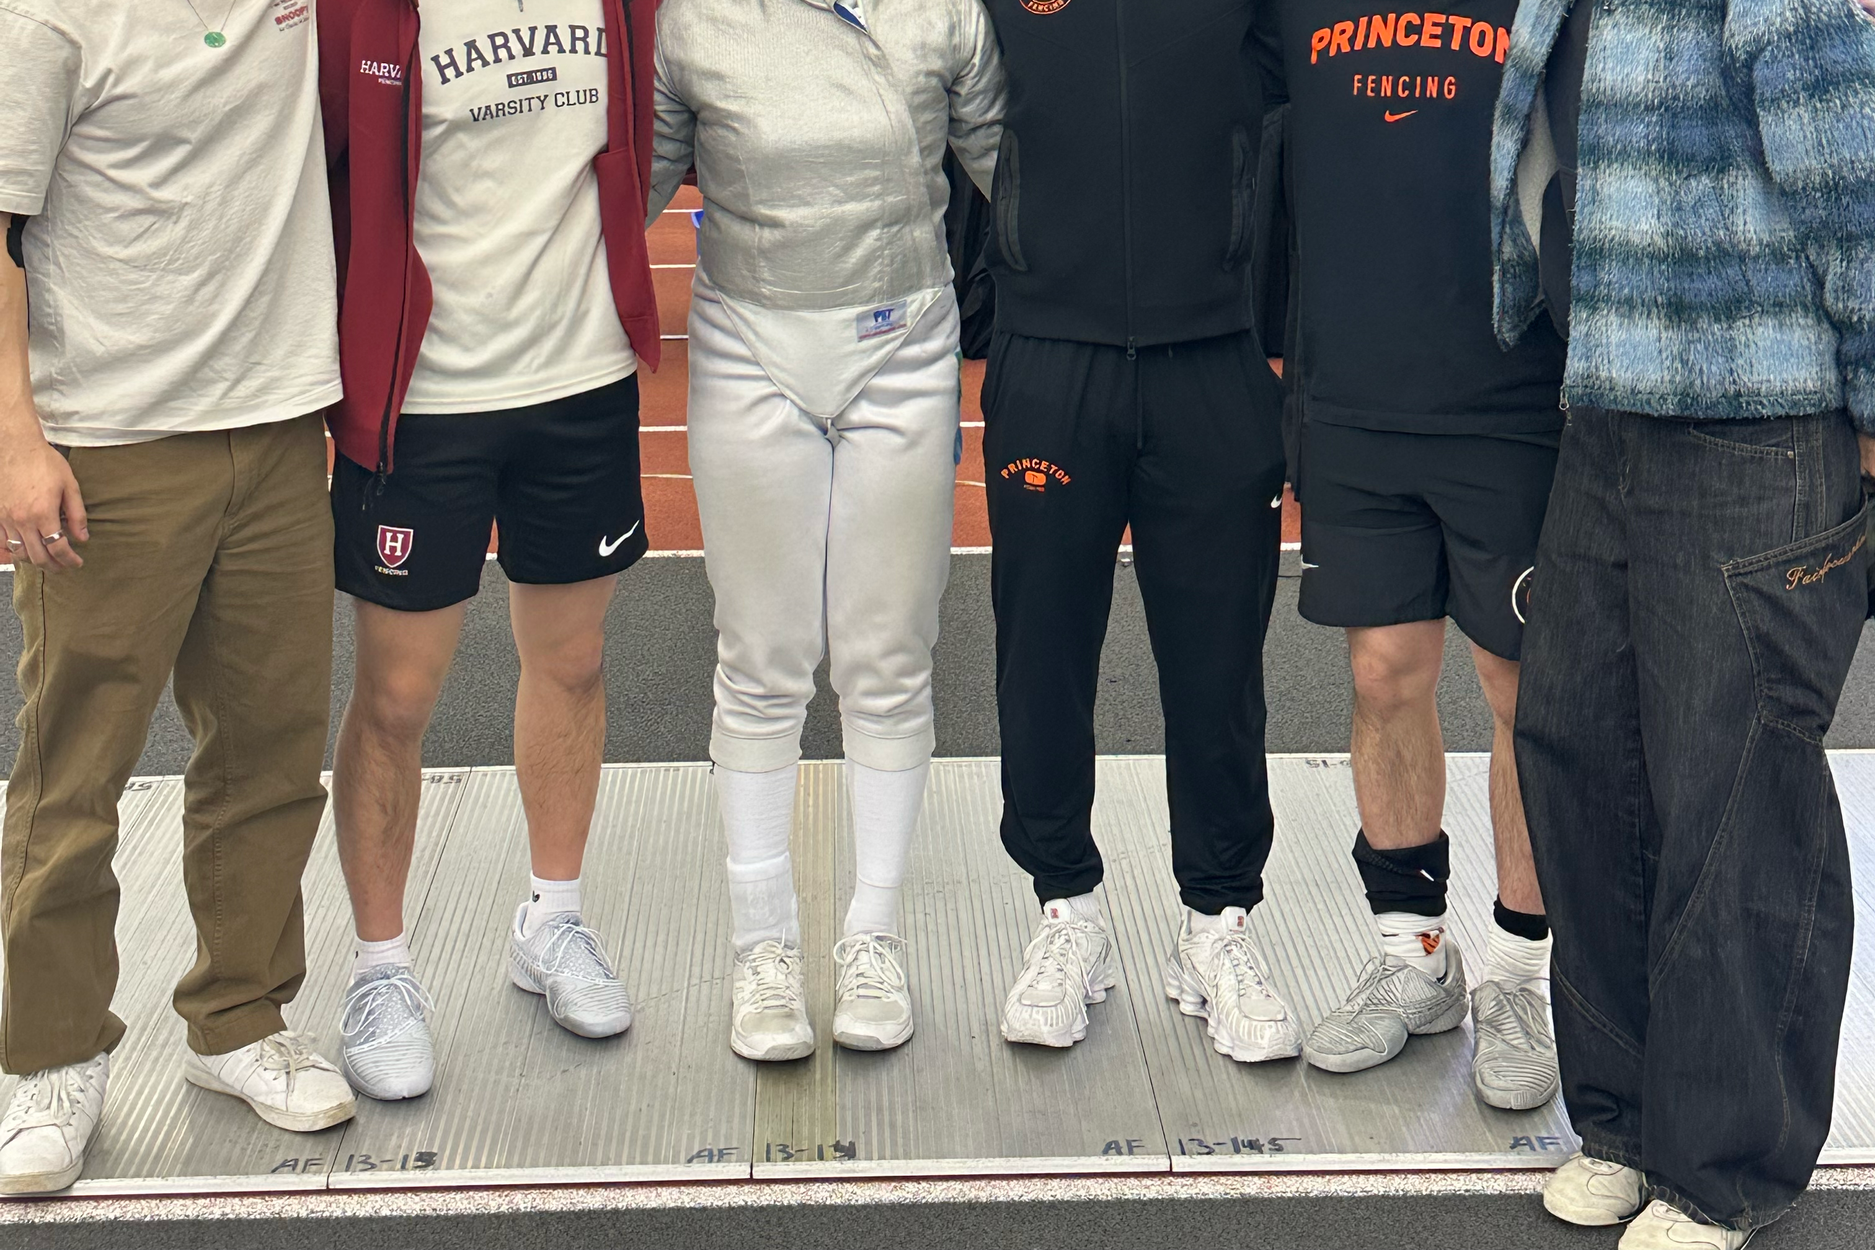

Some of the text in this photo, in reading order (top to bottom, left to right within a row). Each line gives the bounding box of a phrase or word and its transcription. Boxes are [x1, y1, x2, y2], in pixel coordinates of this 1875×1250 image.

[1310, 13, 1511, 65] PRINCETON
[1353, 74, 1456, 99] FENCING
[469, 88, 599, 122] VARSITY CLUB
[1000, 457, 1071, 485] PRINCETON
[384, 532, 405, 556] H
[687, 1146, 741, 1163] AF
[1101, 1138, 1146, 1156] AF
[1509, 1135, 1562, 1152] AF
[271, 1157, 324, 1174] AF
